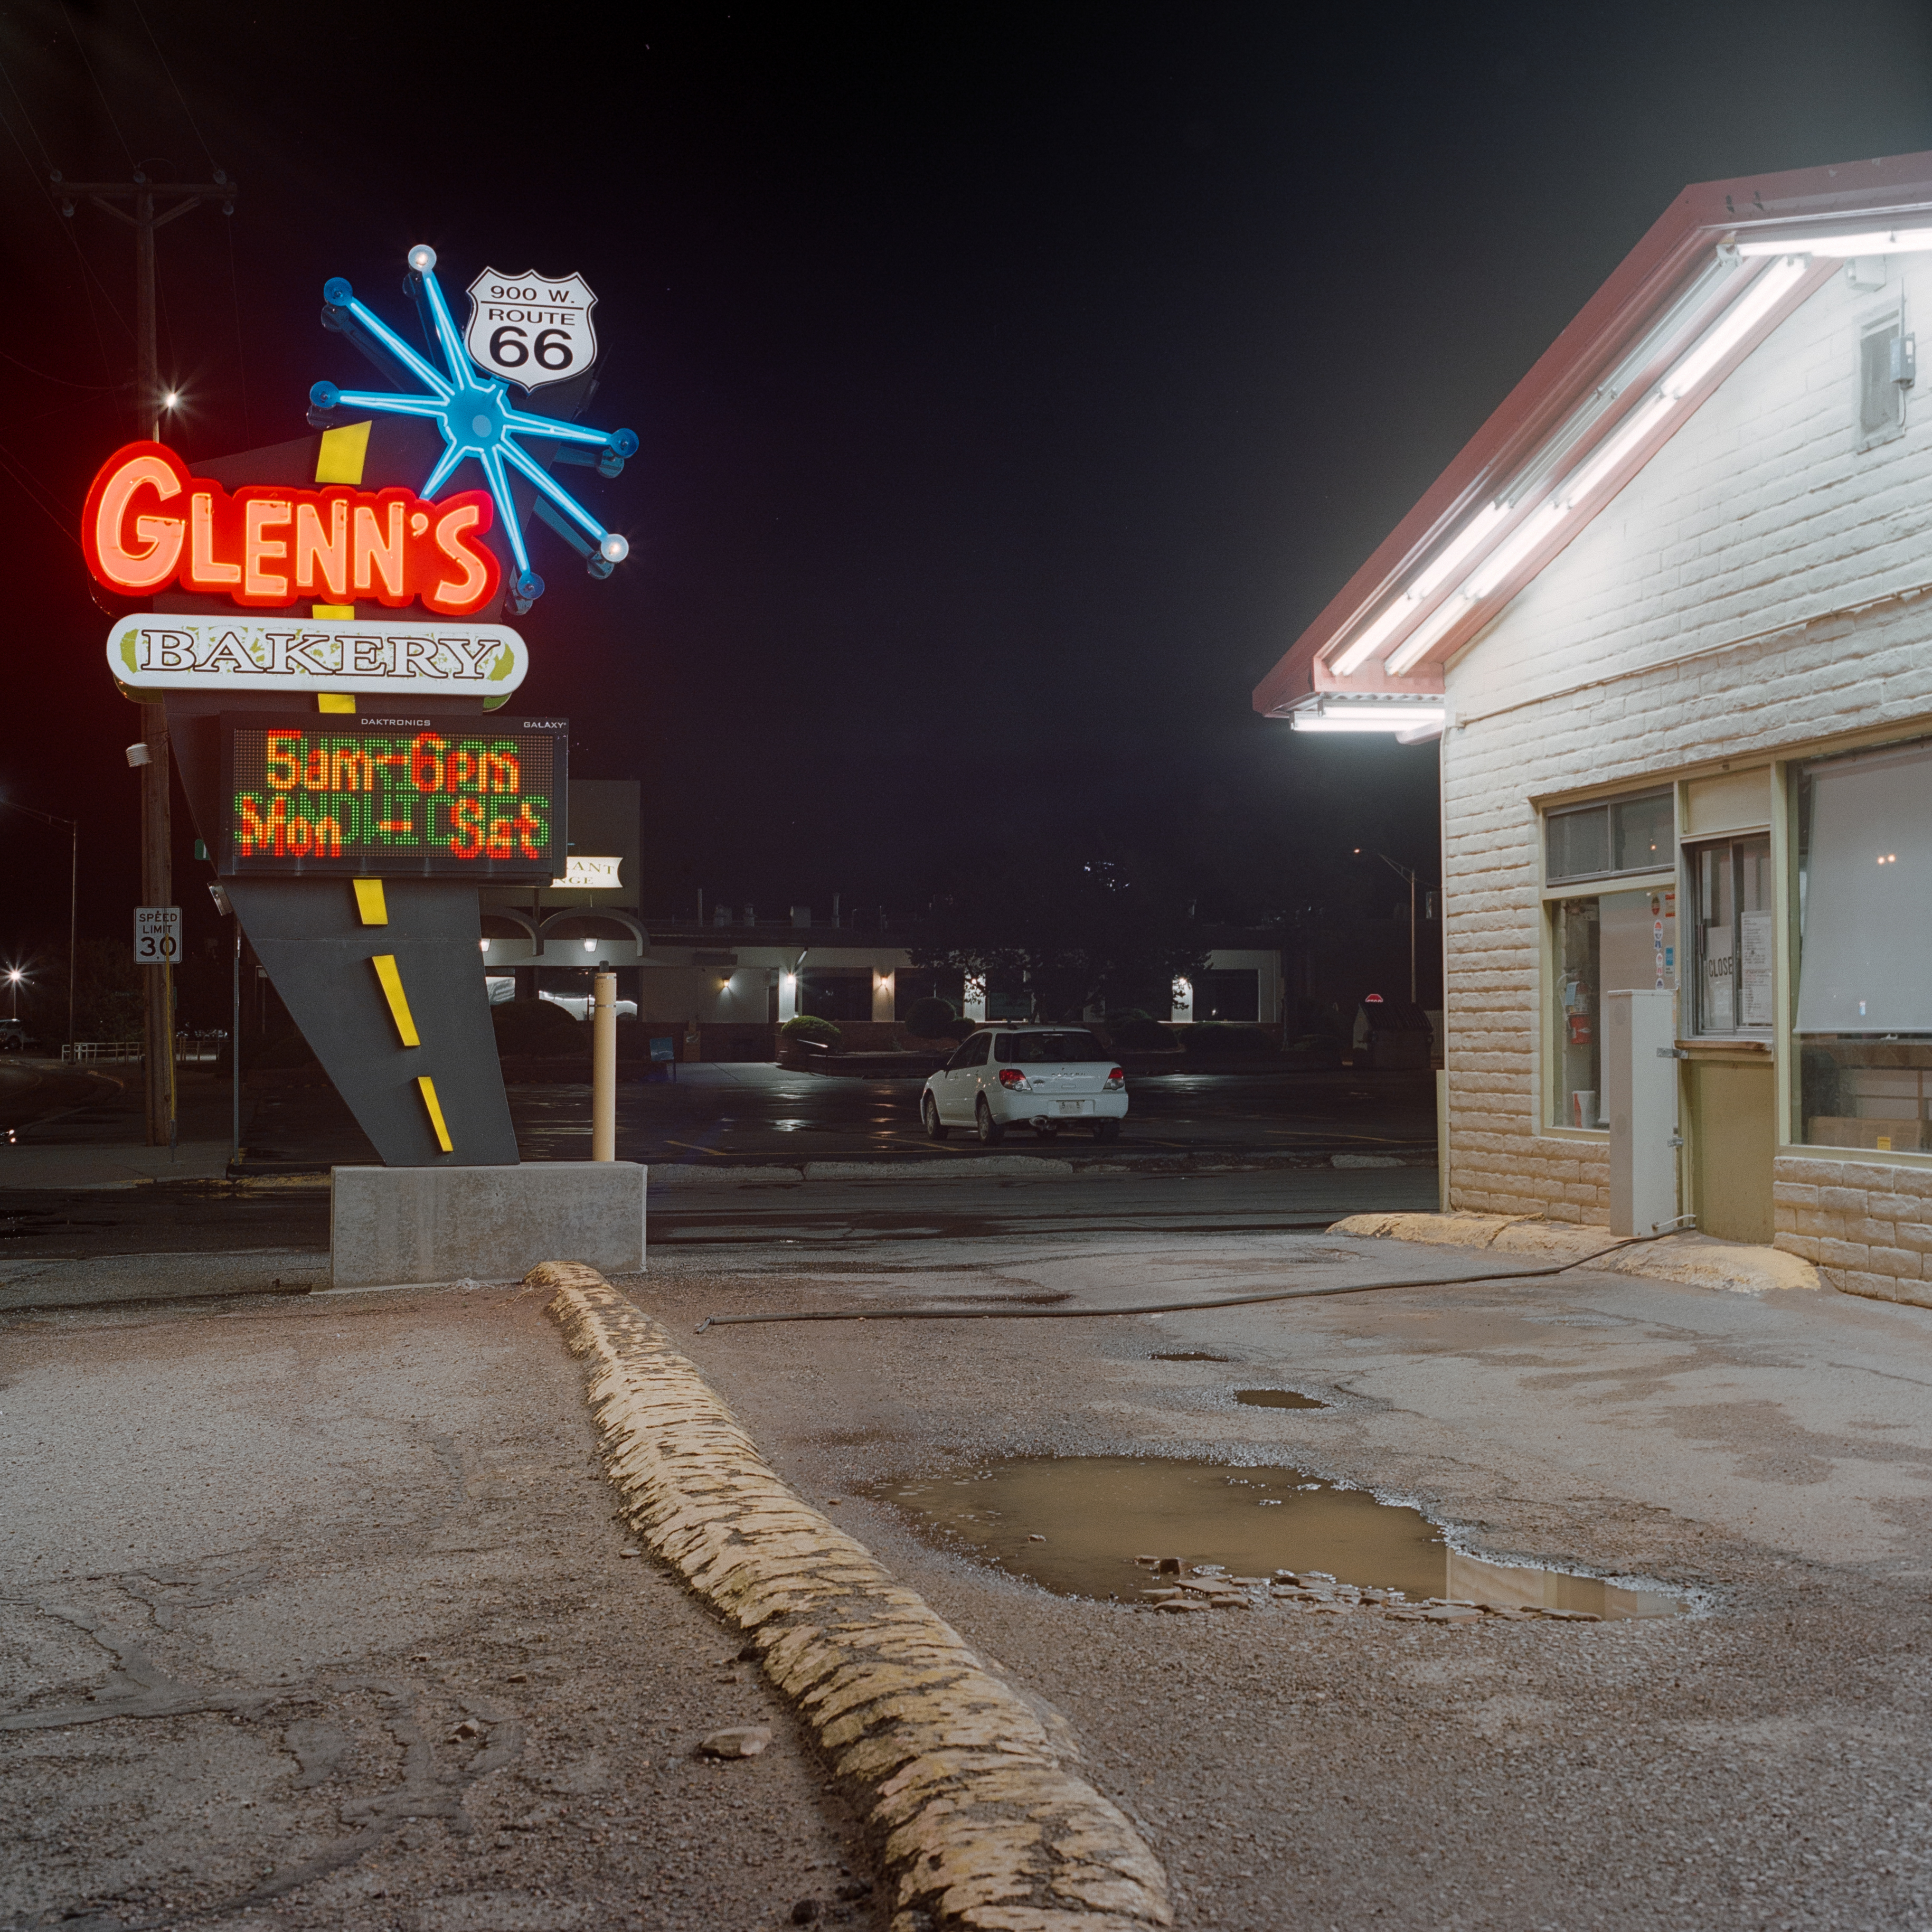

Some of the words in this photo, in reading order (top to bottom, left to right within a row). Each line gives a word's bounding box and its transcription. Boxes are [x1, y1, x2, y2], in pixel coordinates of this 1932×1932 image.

[490, 285, 537, 301] 900
[548, 289, 575, 304] W.
[488, 308, 576, 326] ROUTE
[489, 325, 573, 371] 66
[97, 455, 487, 606] GLENN'S
[141, 629, 501, 680] BAKERY
[567, 861, 615, 874] ANT
[139, 913, 177, 922] SPEED
[143, 925, 173, 934] LIMIT
[139, 936, 177, 957] 30
[1708, 956, 1733, 977] CLOSE
